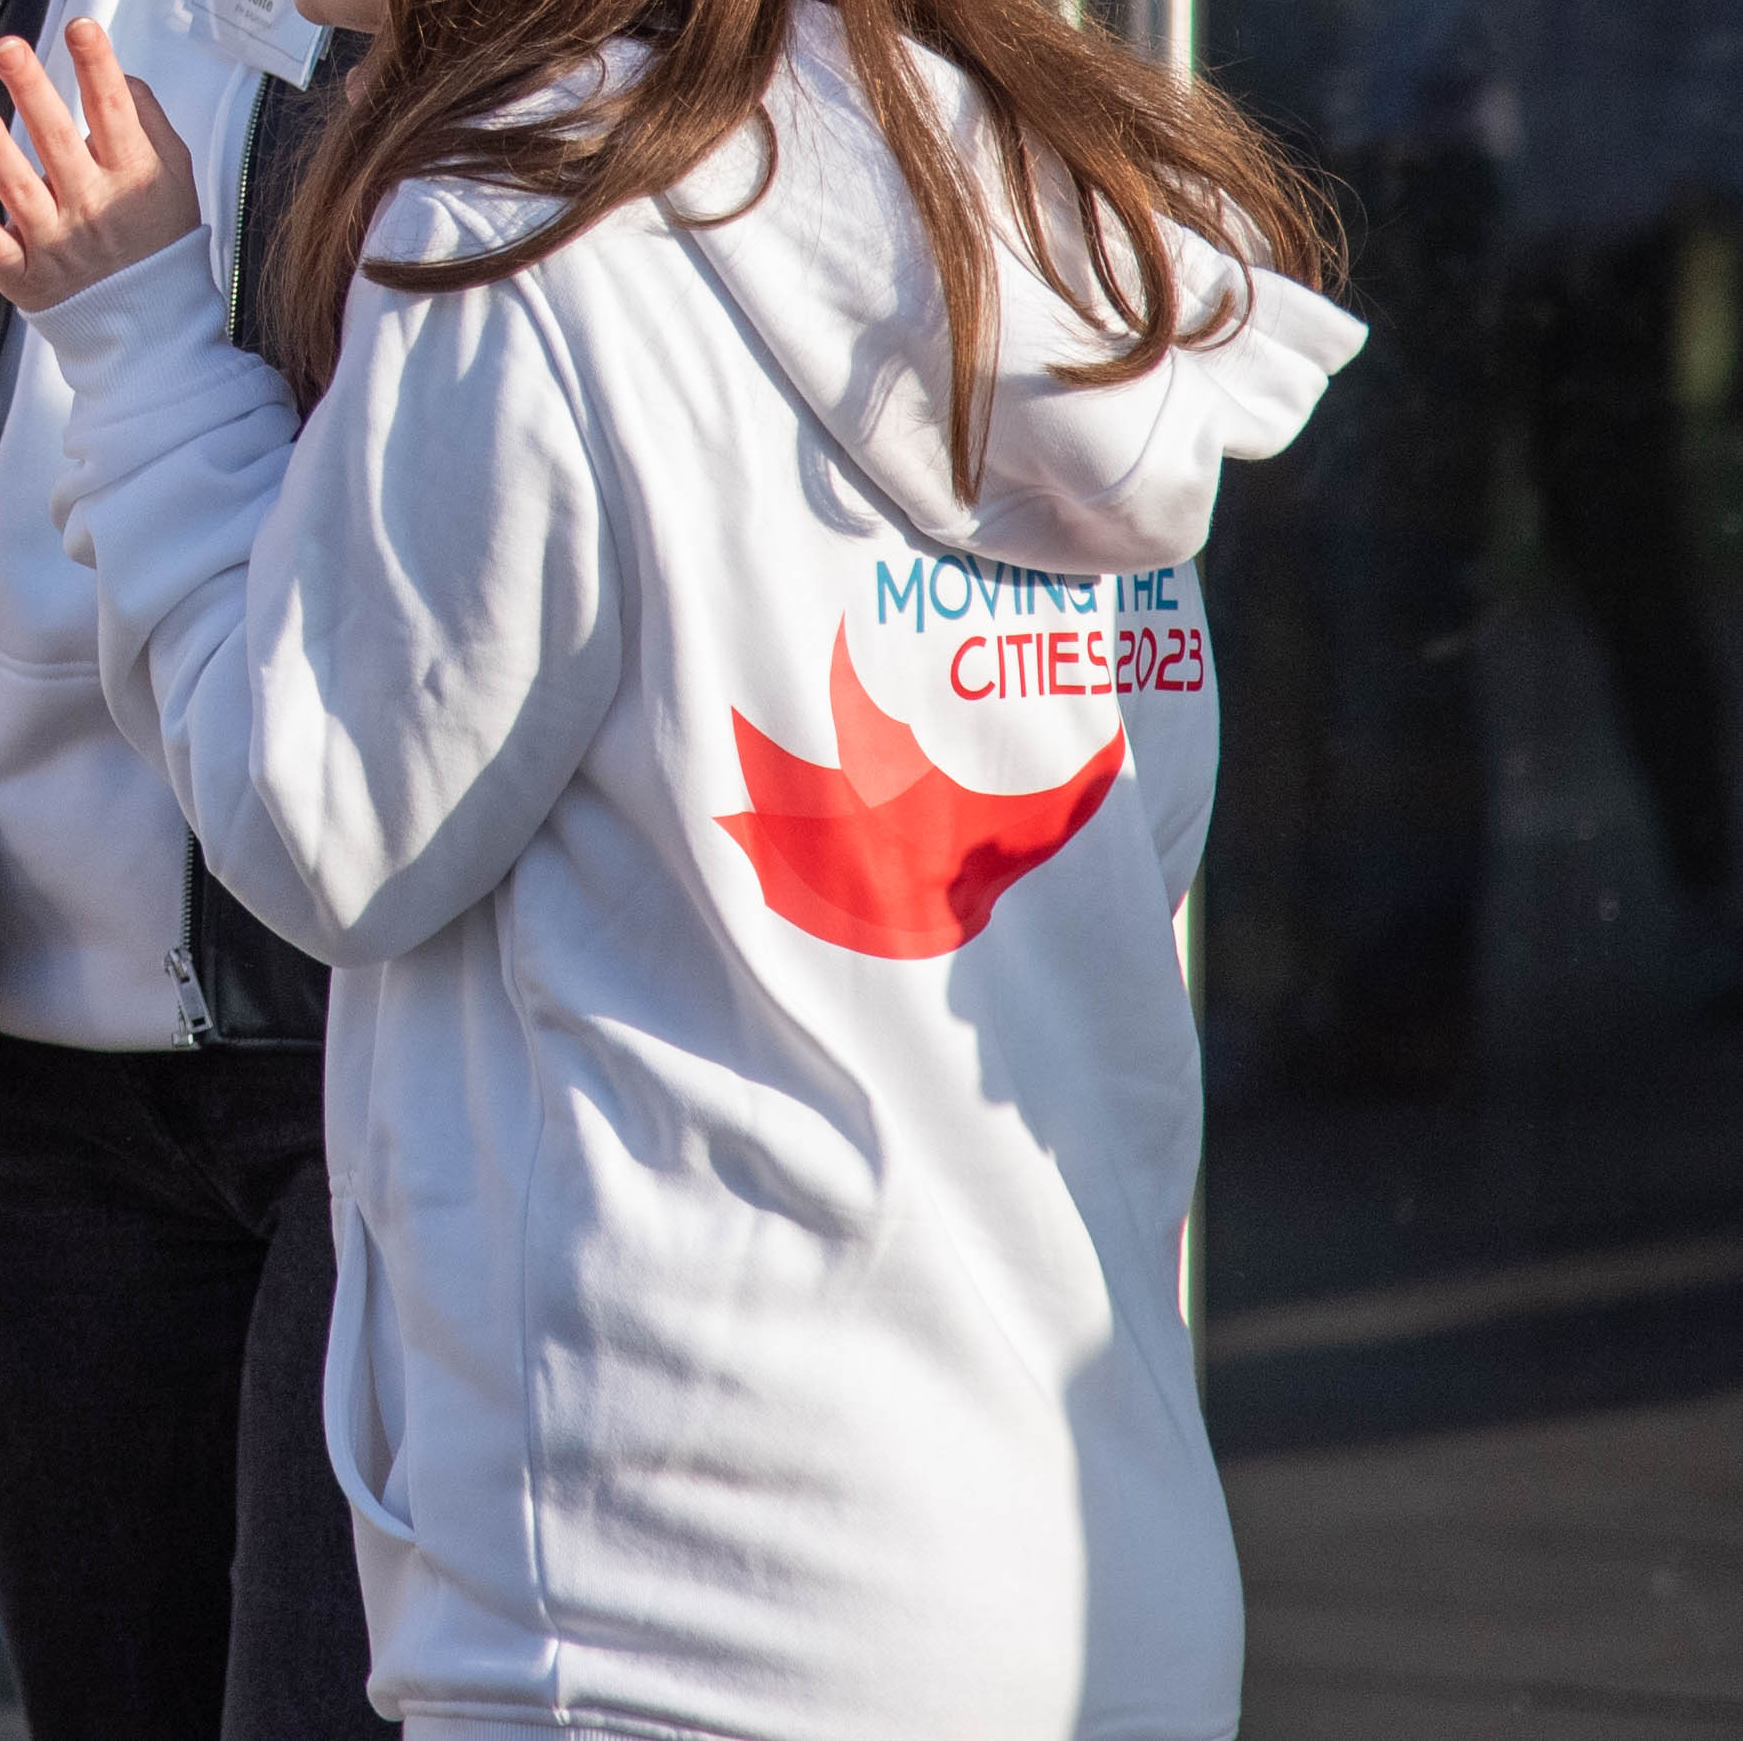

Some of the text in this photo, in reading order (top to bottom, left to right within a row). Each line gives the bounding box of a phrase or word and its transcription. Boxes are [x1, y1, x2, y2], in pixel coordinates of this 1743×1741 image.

[876, 554, 1098, 634] MOVING
[950, 626, 1204, 701] CITIES 2023
